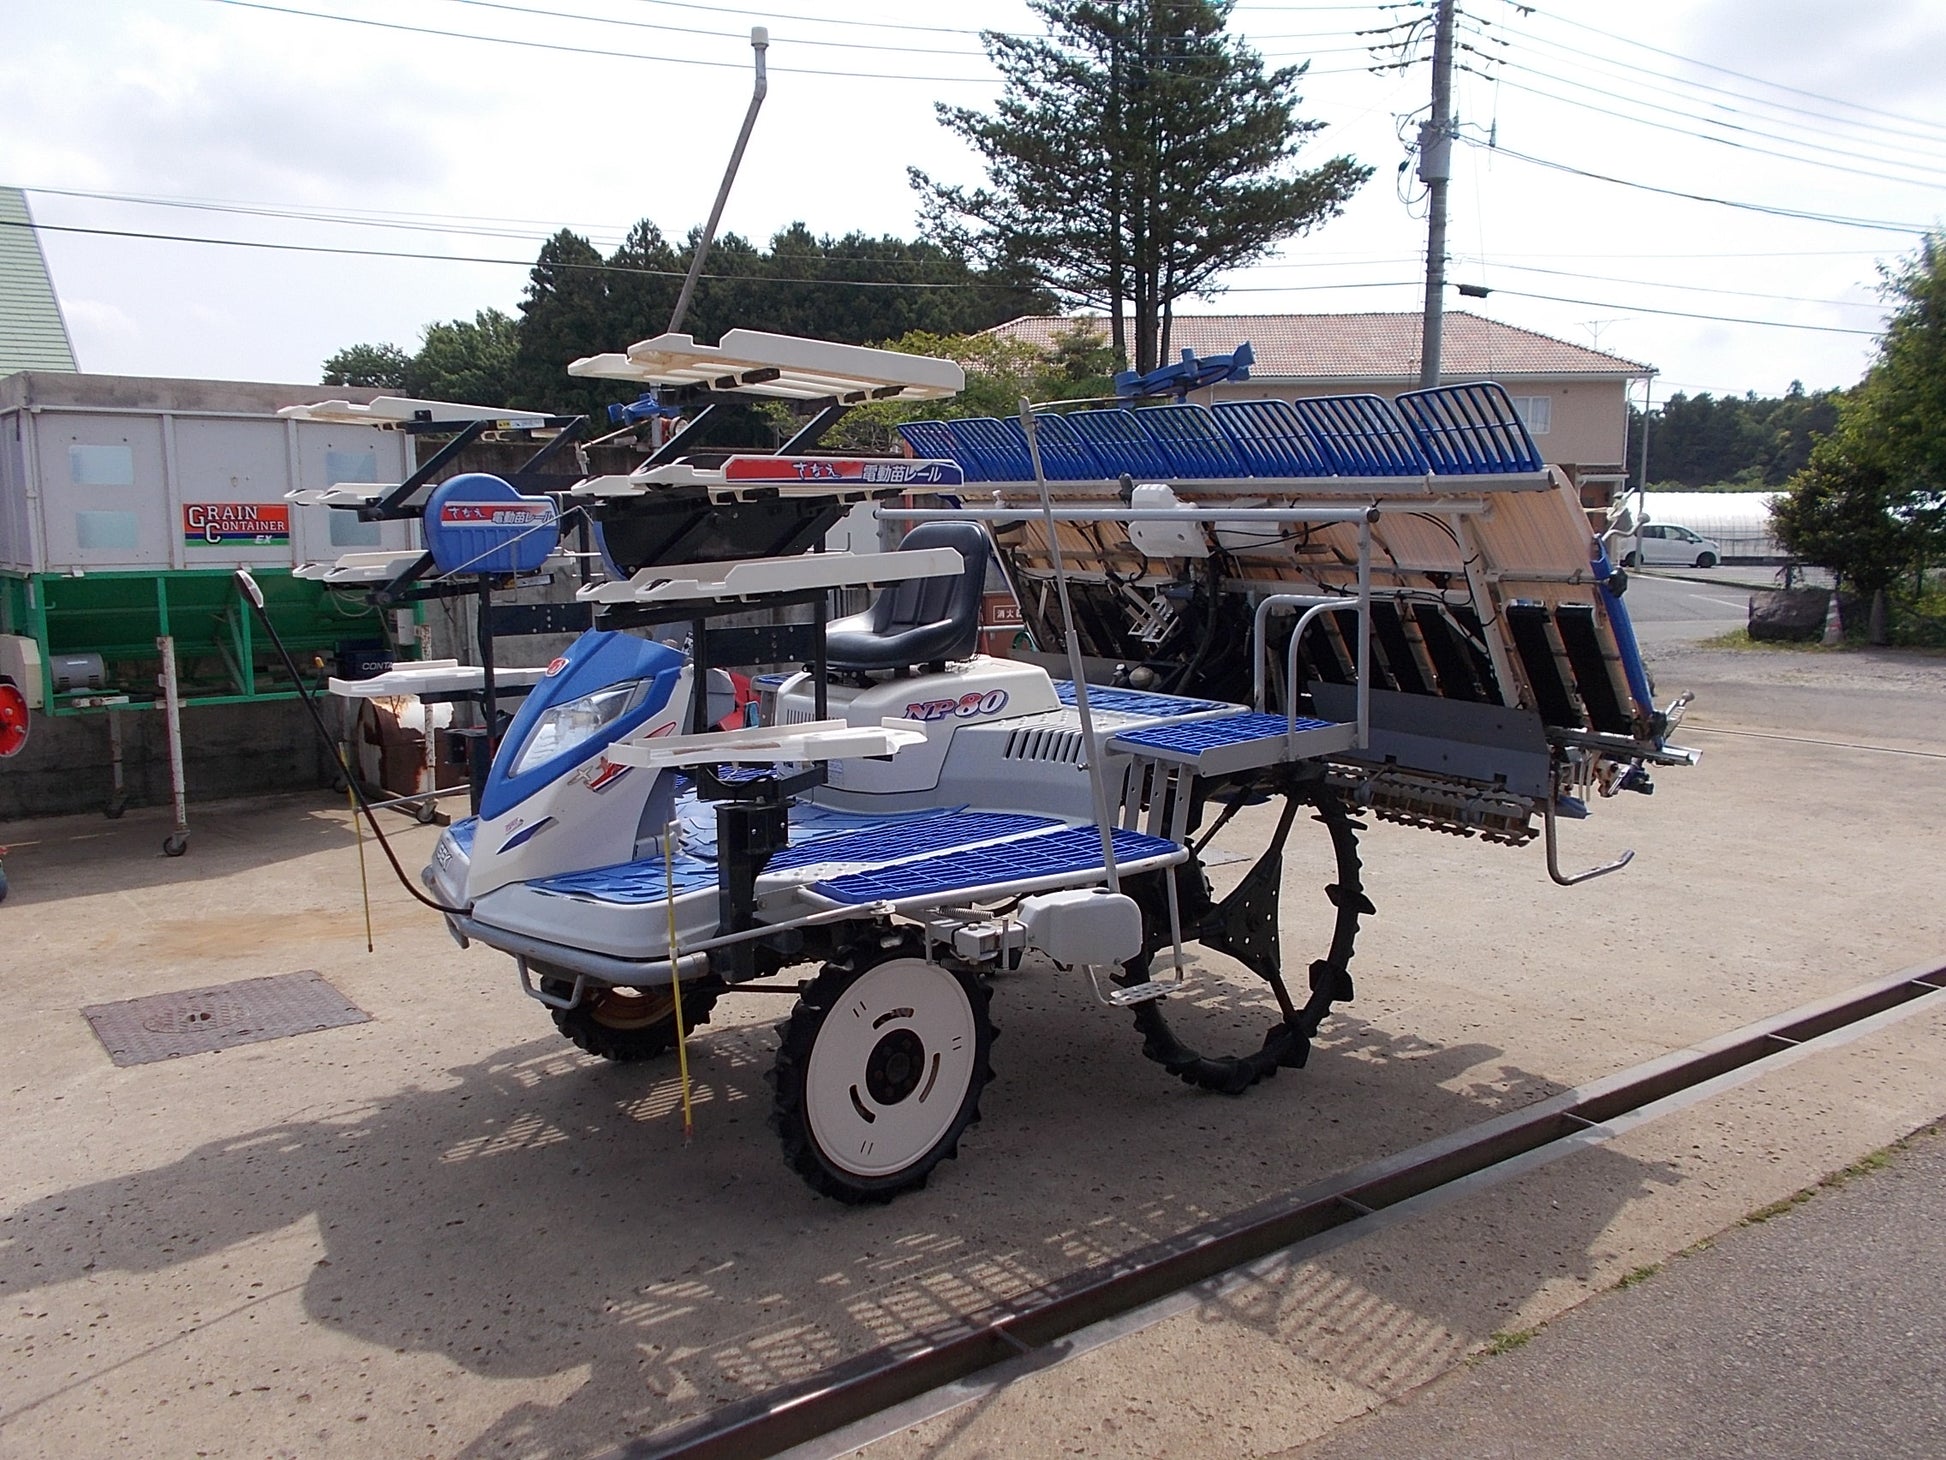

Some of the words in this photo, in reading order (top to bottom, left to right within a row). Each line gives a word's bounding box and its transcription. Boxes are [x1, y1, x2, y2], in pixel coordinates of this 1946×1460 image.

[861, 463, 943, 483] 電動苗レール
[188, 505, 258, 528] GRAIN
[205, 521, 285, 544] CONTAINER
[254, 534, 273, 545] EX
[362, 661, 393, 671] CONTA
[902, 689, 1009, 720] NP80
